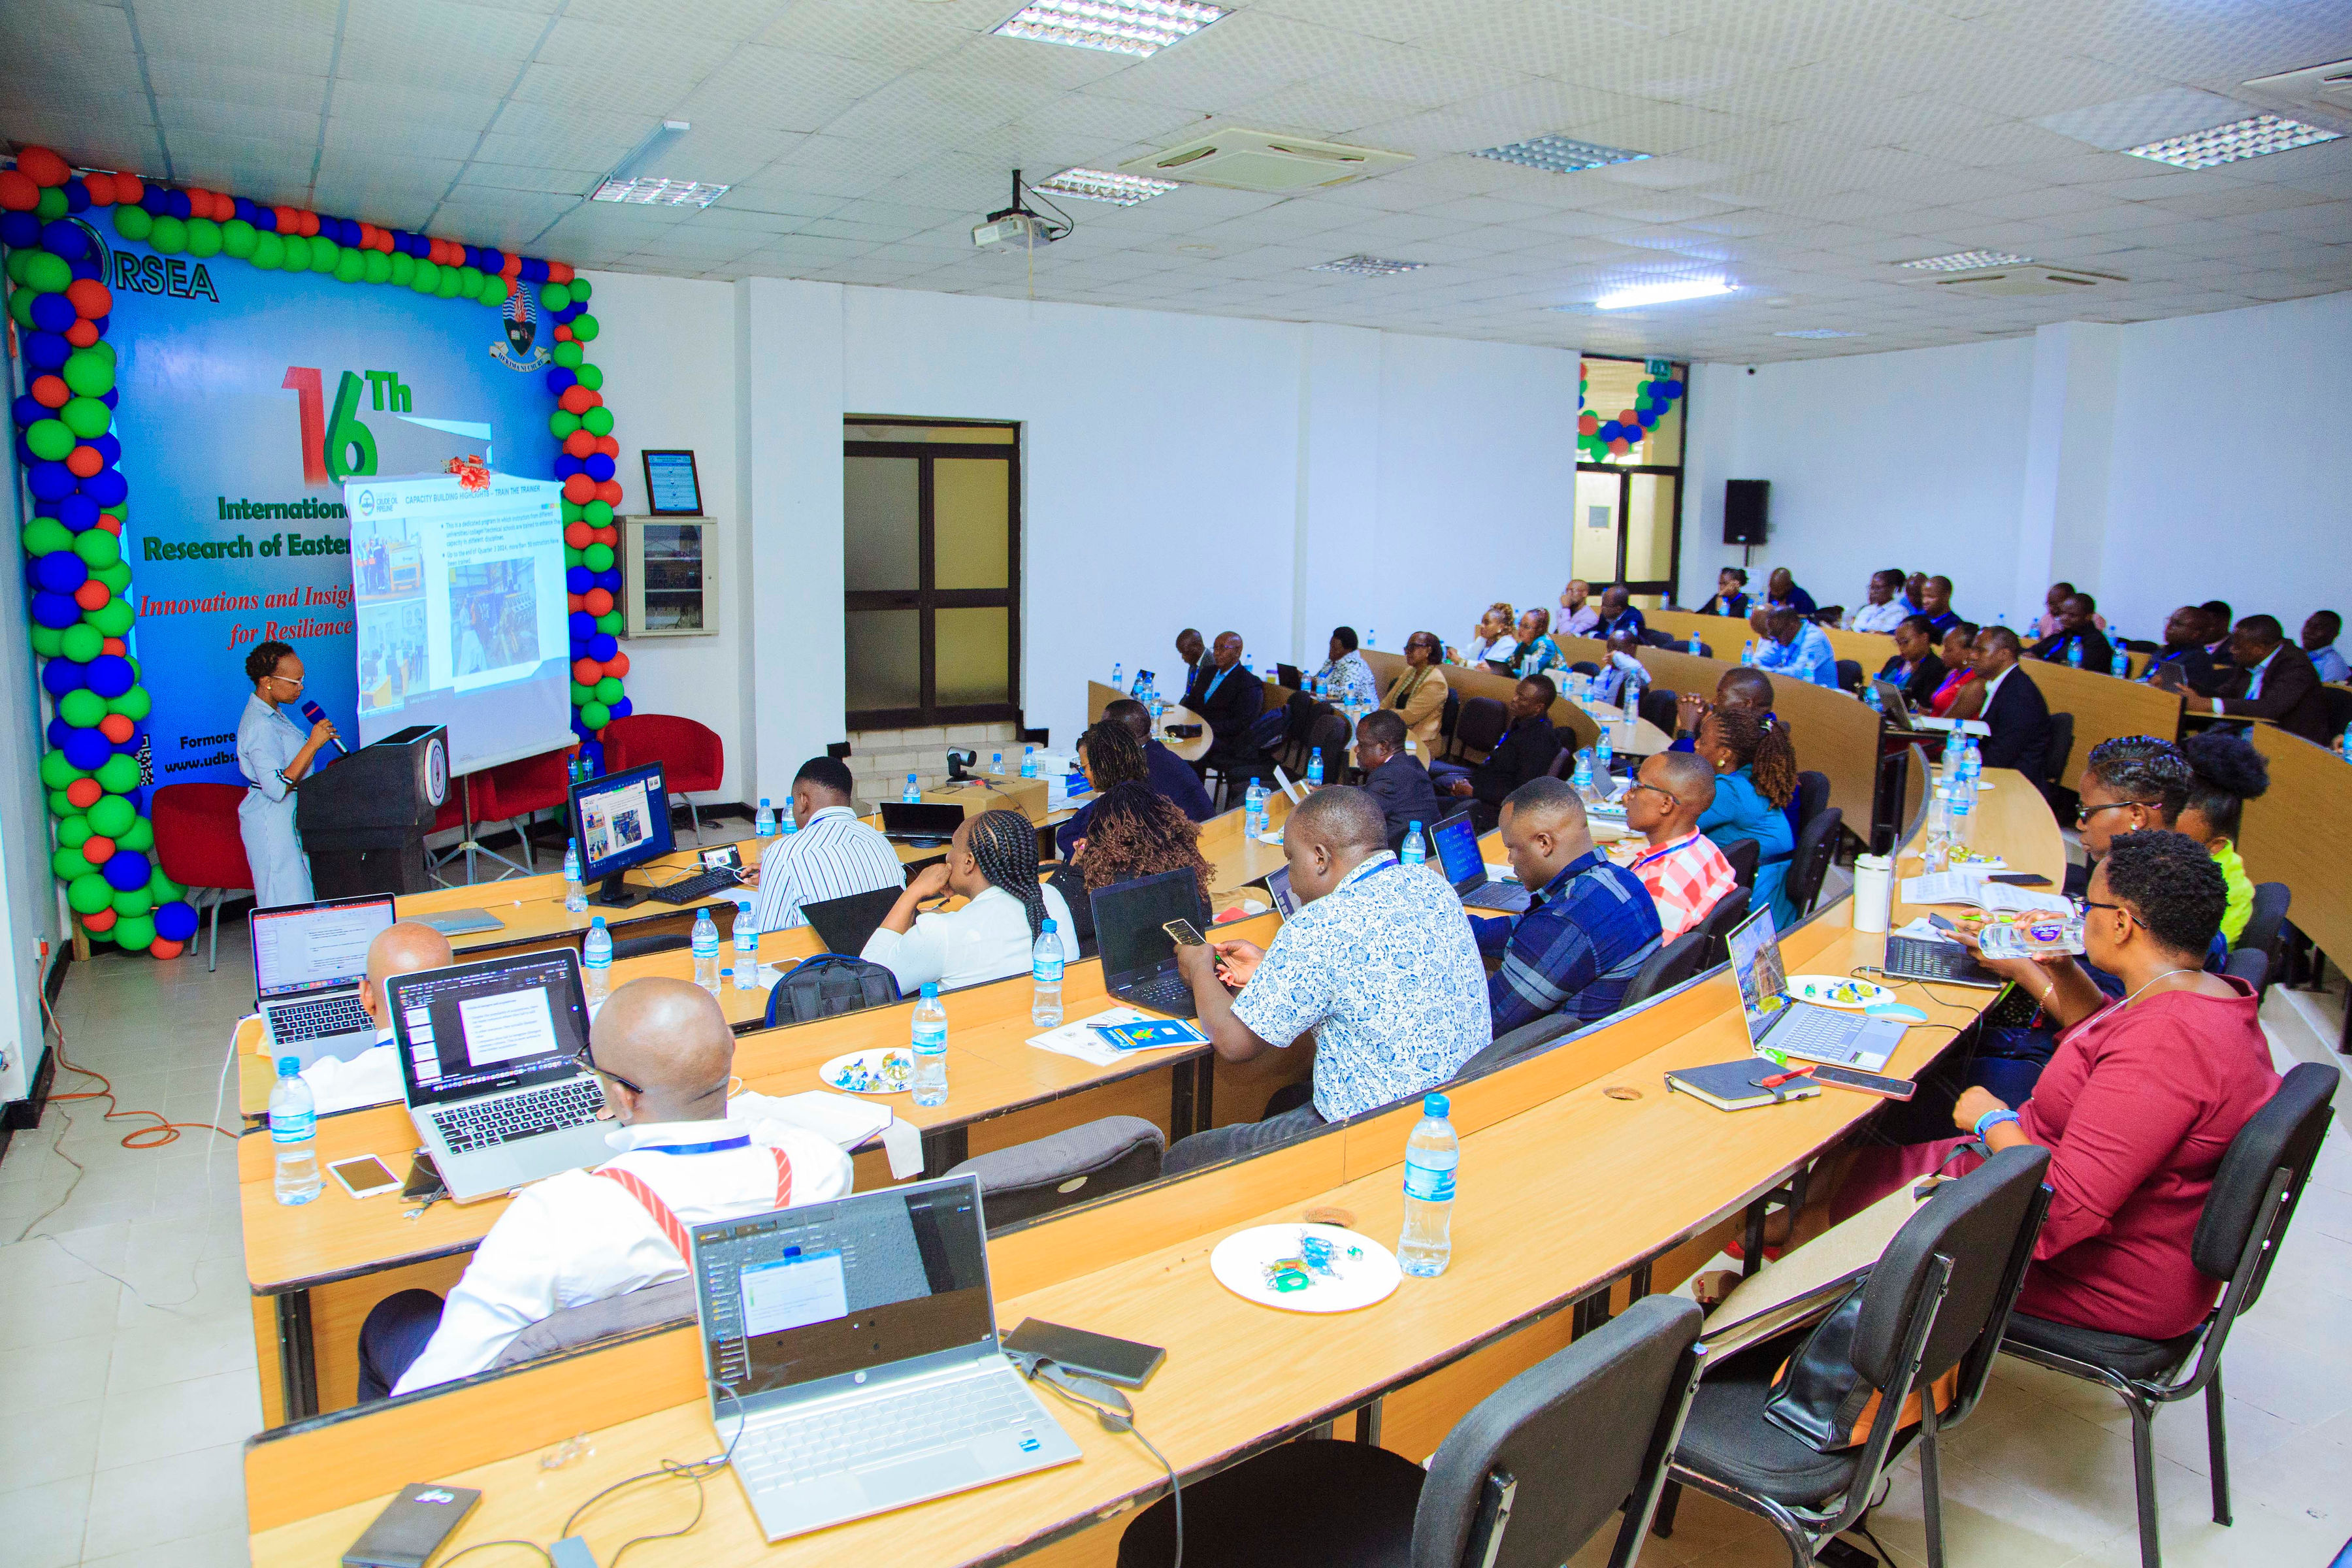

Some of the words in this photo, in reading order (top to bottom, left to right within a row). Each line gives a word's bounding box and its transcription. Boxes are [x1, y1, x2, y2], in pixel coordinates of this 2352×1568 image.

[405, 495, 432, 504] CAPACITY
[433, 493, 458, 502] BUILDING
[459, 490, 490, 500] HIGHLIGHTS
[495, 487, 509, 496] TRAIN
[521, 485, 541, 493] TRAINER
[218, 497, 349, 520] Internation
[143, 533, 253, 561] Research
[259, 532, 282, 557] of
[139, 591, 259, 617] Innovations
[265, 587, 299, 609] and
[227, 623, 259, 651] for
[265, 618, 353, 642] Resilience
[180, 732, 236, 750] Formore
